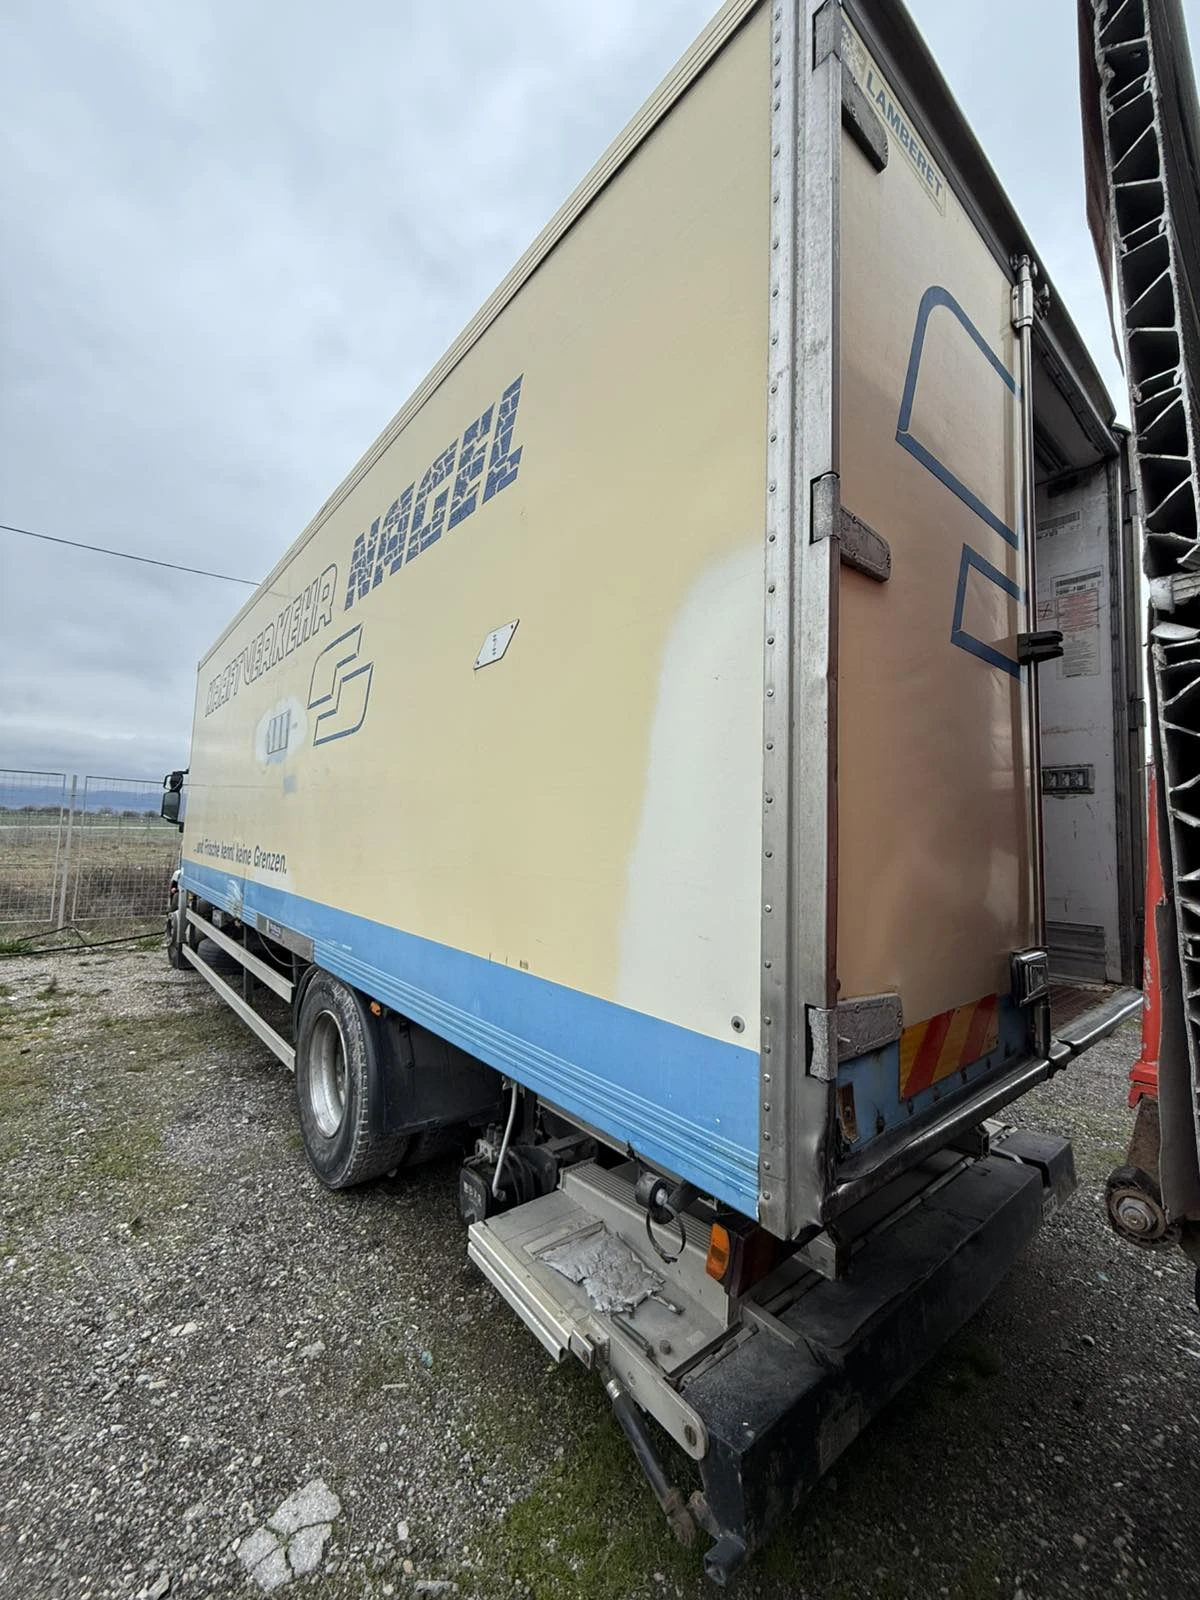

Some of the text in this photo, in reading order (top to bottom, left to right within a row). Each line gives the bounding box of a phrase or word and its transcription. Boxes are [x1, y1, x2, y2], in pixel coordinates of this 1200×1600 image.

[866, 70, 942, 197] LAMBERET
[344, 373, 524, 612] NAGEL
[235, 843, 252, 866] keine
[253, 844, 287, 874] Grenzen.
